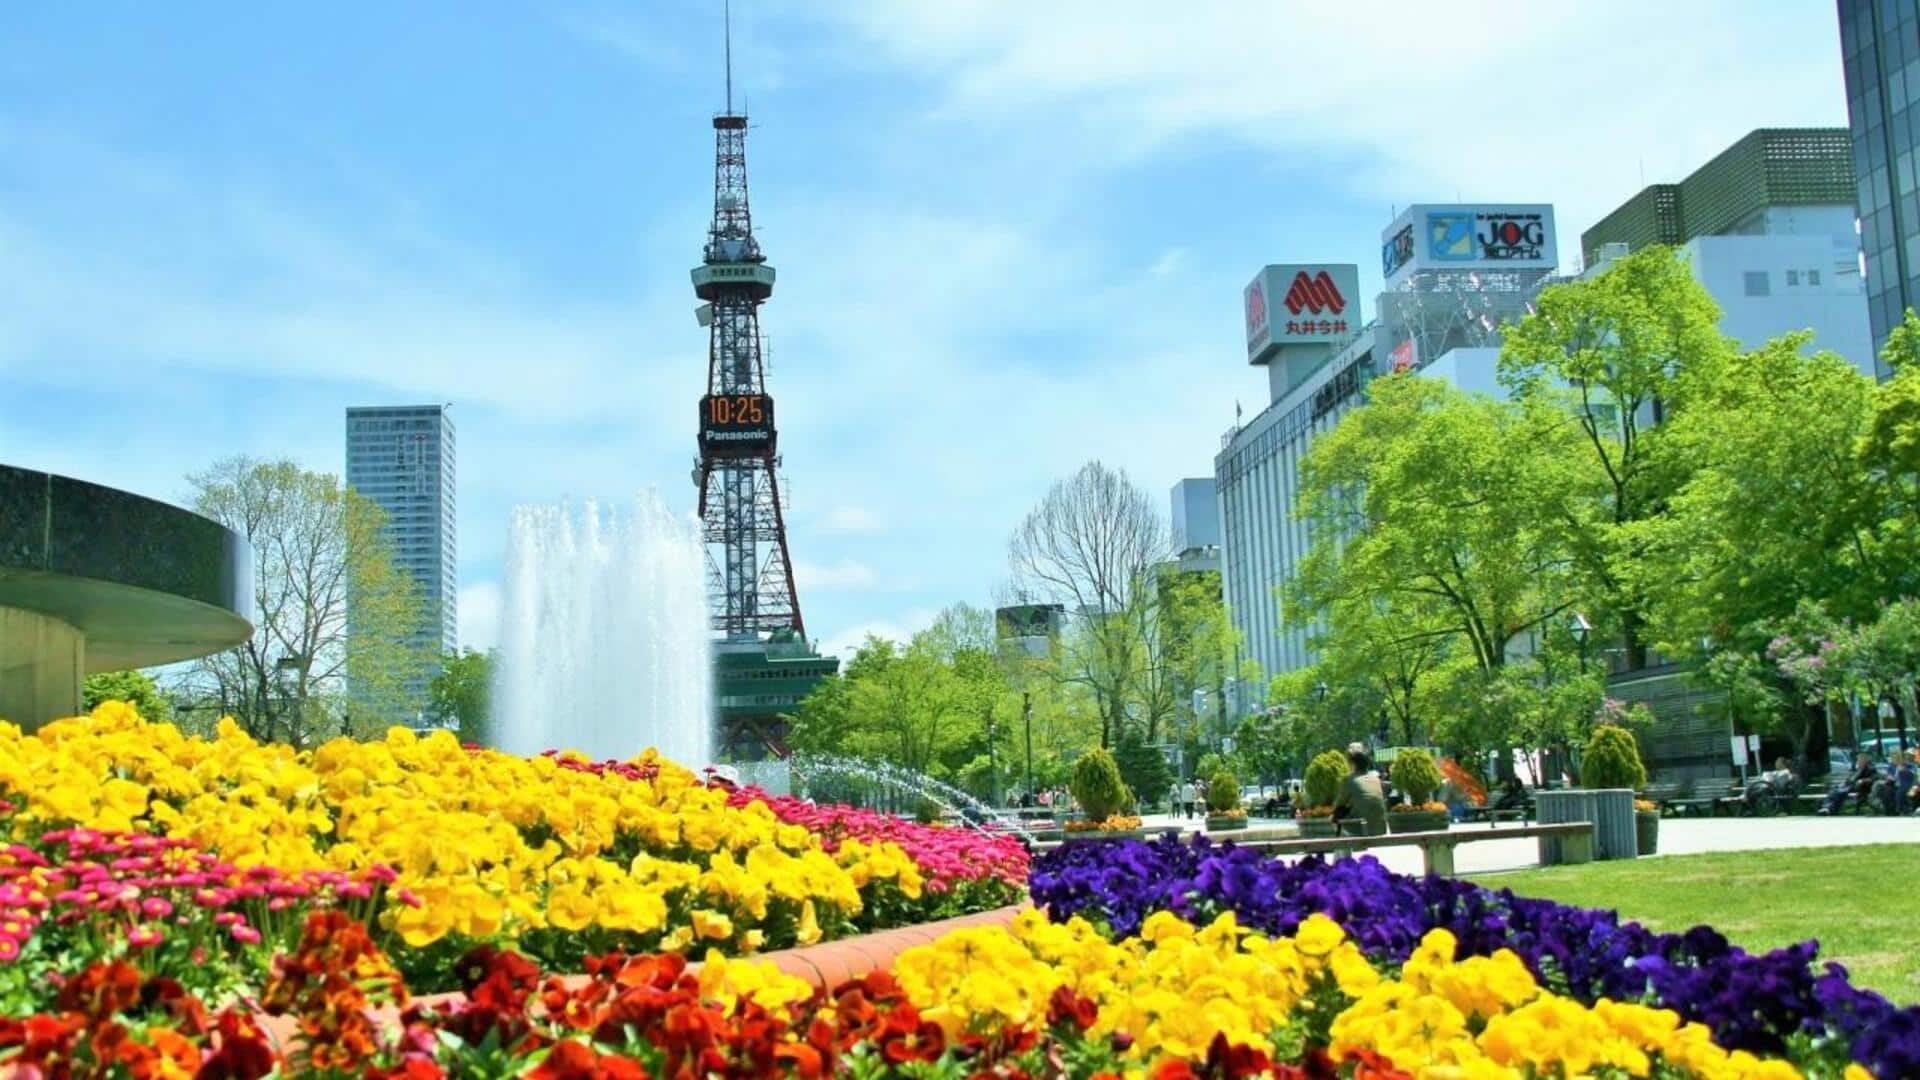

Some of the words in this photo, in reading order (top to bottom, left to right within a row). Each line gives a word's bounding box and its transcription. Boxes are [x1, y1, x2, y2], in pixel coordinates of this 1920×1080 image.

[1477, 222, 1544, 247] JOG
[1285, 320, 1346, 336] 丸井今井
[709, 396, 762, 424] 10:25
[705, 429, 769, 441] Panasonic
